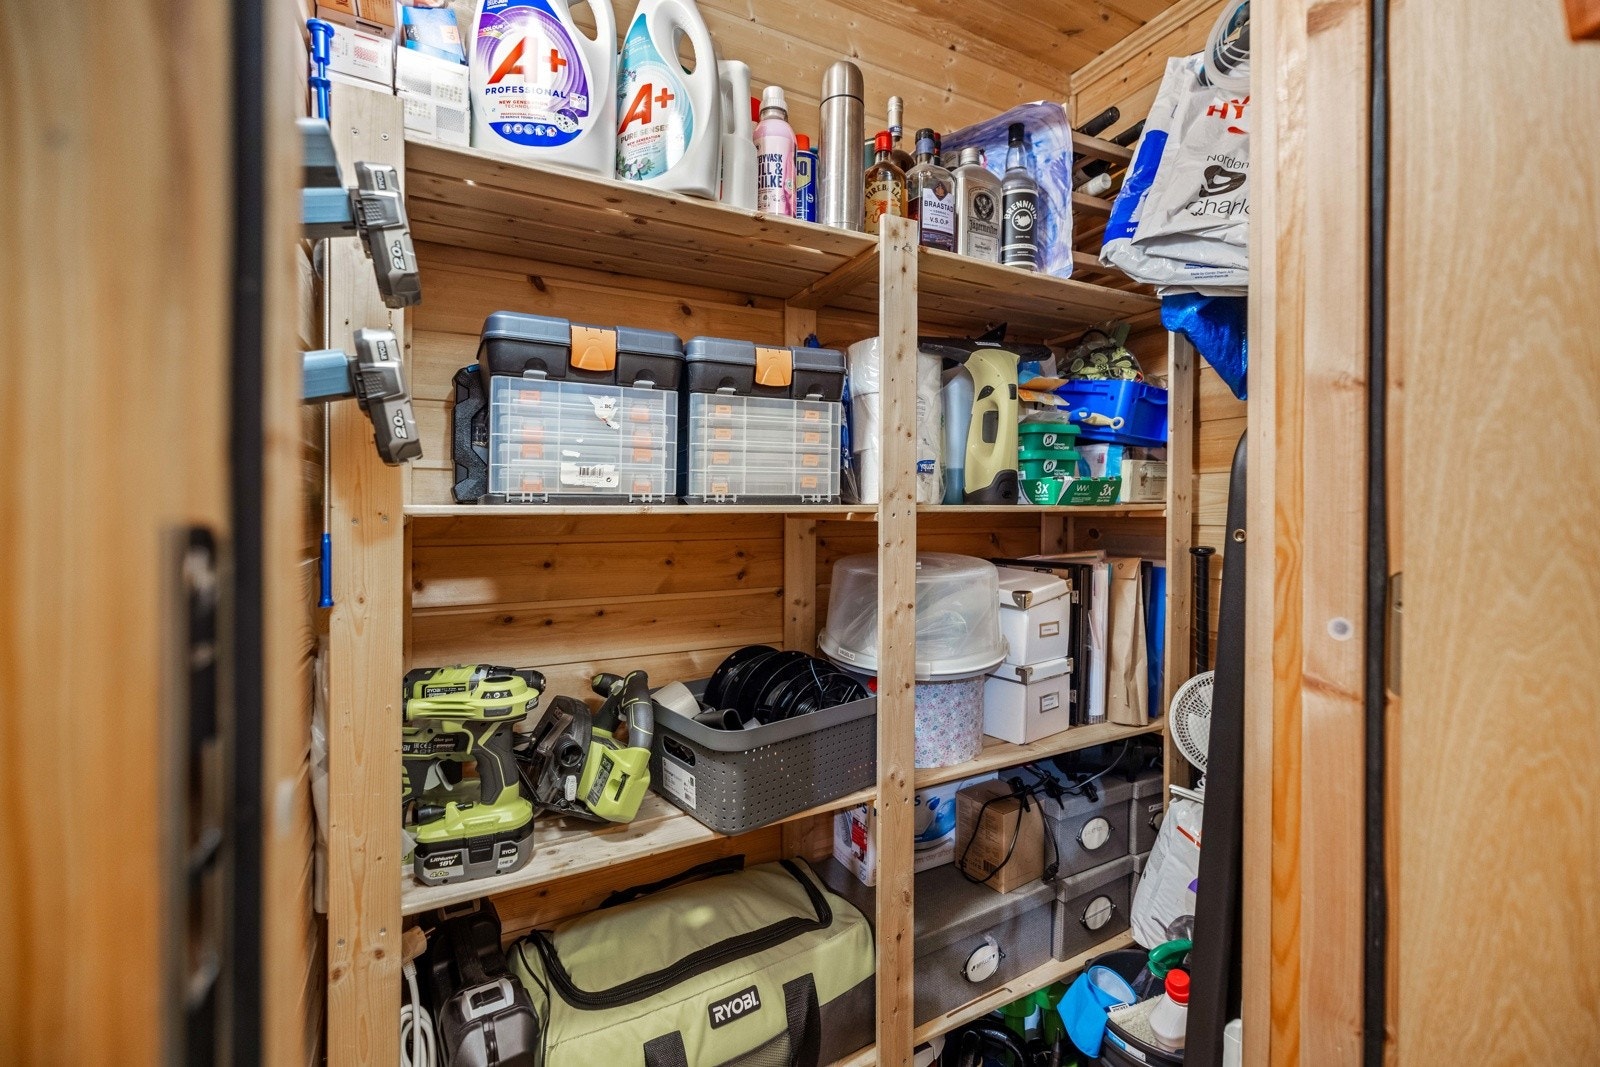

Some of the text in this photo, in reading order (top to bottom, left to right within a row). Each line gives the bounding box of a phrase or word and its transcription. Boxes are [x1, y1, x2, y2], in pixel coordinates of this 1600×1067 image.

[485, 86, 567, 99] PROFESSIONAL
[617, 83, 675, 136] A+
[620, 131, 638, 144] PURE
[924, 200, 954, 213] BRAASTAD
[439, 860, 455, 868] 18V
[712, 990, 759, 1023] RYOBI
